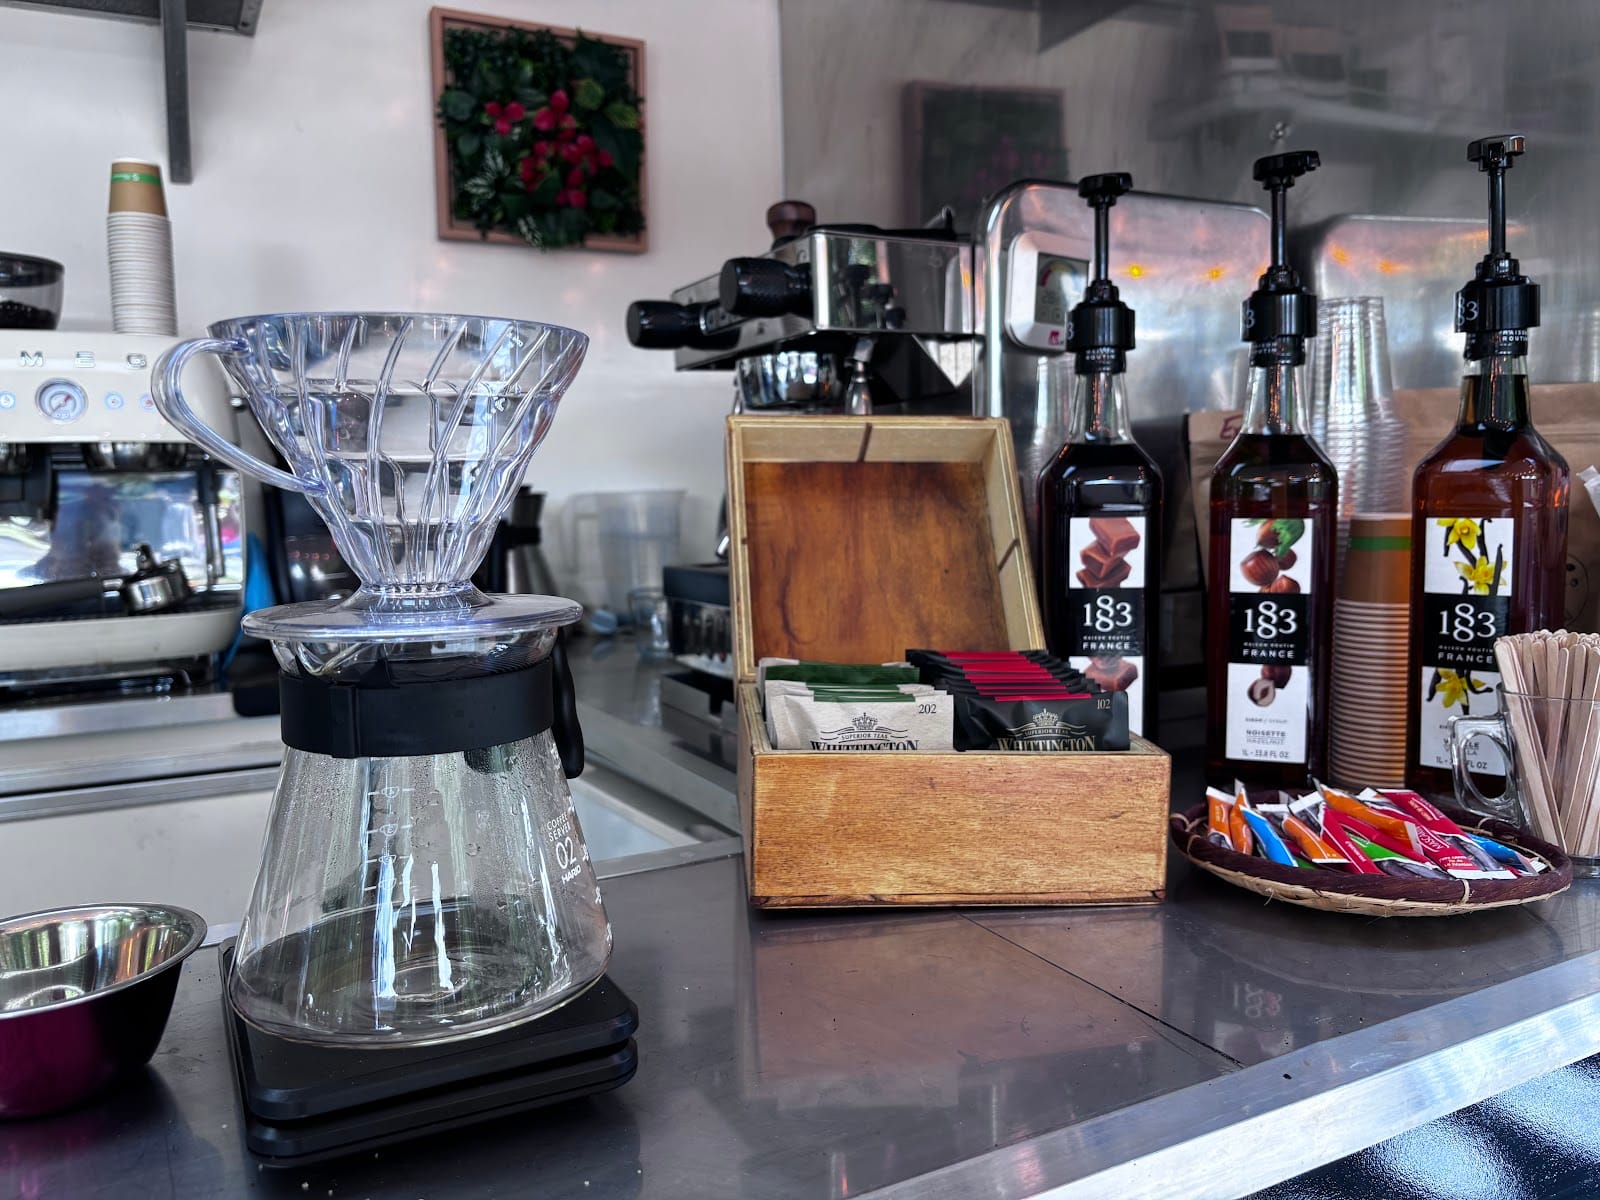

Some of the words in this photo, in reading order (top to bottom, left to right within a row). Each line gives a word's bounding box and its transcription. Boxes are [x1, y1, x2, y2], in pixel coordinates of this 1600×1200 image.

[1082, 641, 1130, 650] FRANCE
[1242, 648, 1295, 659] FRANCE
[1438, 652, 1493, 663] FRANCE
[918, 703, 937, 714] 202
[1097, 698, 1111, 710] 102
[1025, 728, 1053, 736] SUPERIOR
[997, 736, 1096, 751] WHITTINGTON
[546, 812, 568, 831] COFFEE
[556, 836, 577, 869] 02
[561, 864, 582, 885] HARIO
